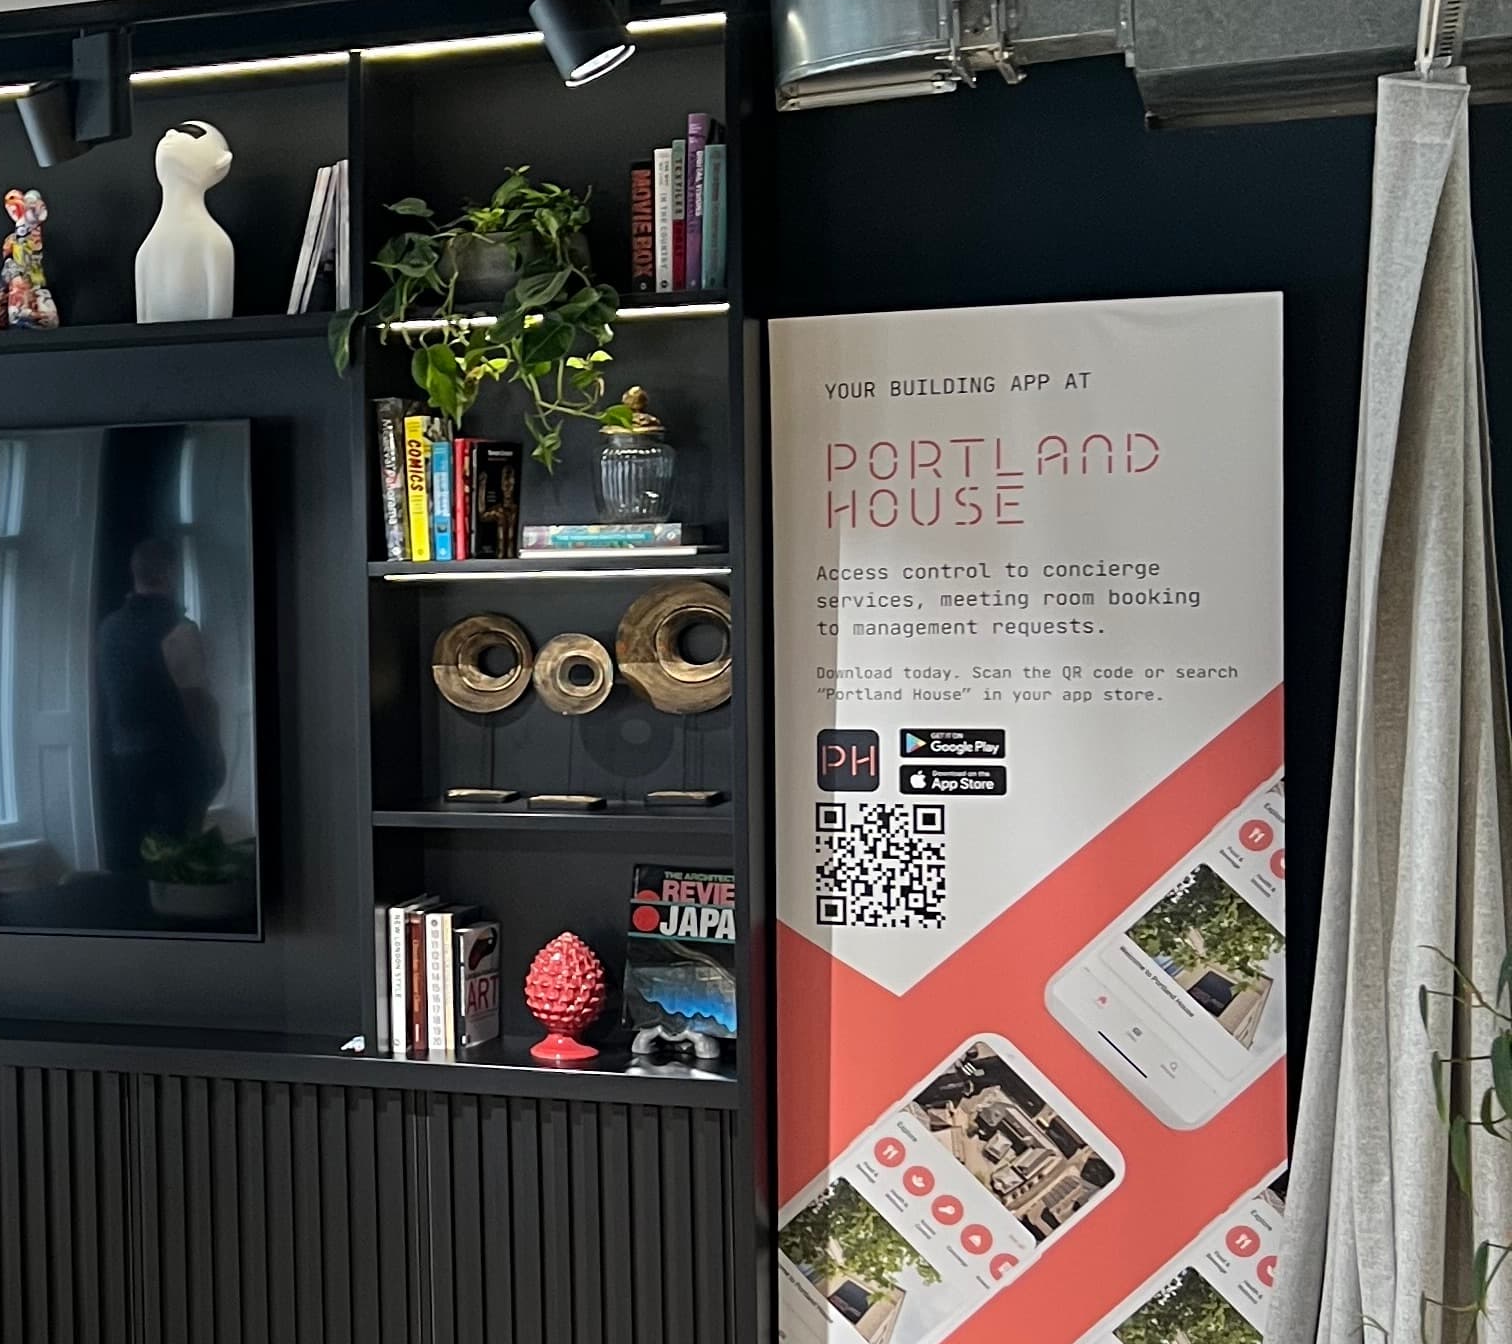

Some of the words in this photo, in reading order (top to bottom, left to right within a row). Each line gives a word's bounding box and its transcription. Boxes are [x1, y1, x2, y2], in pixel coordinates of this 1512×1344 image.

[632, 169, 652, 233] MOVIE
[675, 158, 684, 215] TEXTILES
[632, 237, 653, 278] BOX
[825, 381, 876, 400] YOUR
[890, 376, 996, 397] BUILDING
[1010, 373, 1050, 393] APP
[1065, 371, 1092, 390] AT
[407, 439, 424, 492] COMICS
[827, 432, 1160, 483] PORTLAND
[827, 485, 1025, 529] HOUSE
[816, 565, 889, 582] Access
[903, 562, 991, 580] control
[1004, 562, 1029, 578] to
[1043, 560, 1160, 581] concierge
[816, 592, 924, 611] services,
[940, 590, 1029, 610] meeting
[1044, 592, 1095, 607] room
[1108, 588, 1201, 609] booking
[816, 620, 839, 636] to
[853, 619, 979, 638] management
[992, 618, 1105, 638] requests.
[817, 665, 893, 680] Download
[903, 665, 960, 682] today.
[972, 665, 1012, 680] Scan
[1022, 665, 1051, 679] the
[1062, 665, 1082, 682] QR
[1093, 665, 1135, 679] code
[1145, 667, 1165, 679] or
[1176, 665, 1238, 679] search
[983, 687, 1002, 701] in
[1012, 689, 1052, 705] your
[1062, 690, 1092, 705] app
[1104, 687, 1164, 702] store.
[822, 744, 876, 777] PH
[930, 740, 973, 755] Google
[975, 740, 1000, 755] Play
[931, 778, 958, 792] App
[960, 777, 995, 790] Store
[662, 879, 736, 908] REVIE
[393, 914, 402, 934] NEW
[659, 905, 736, 940] JAPA
[393, 936, 401, 970] LONDON
[394, 972, 403, 999] STYLE
[466, 976, 500, 1014] ART
[1151, 975, 1177, 1000] Portland
